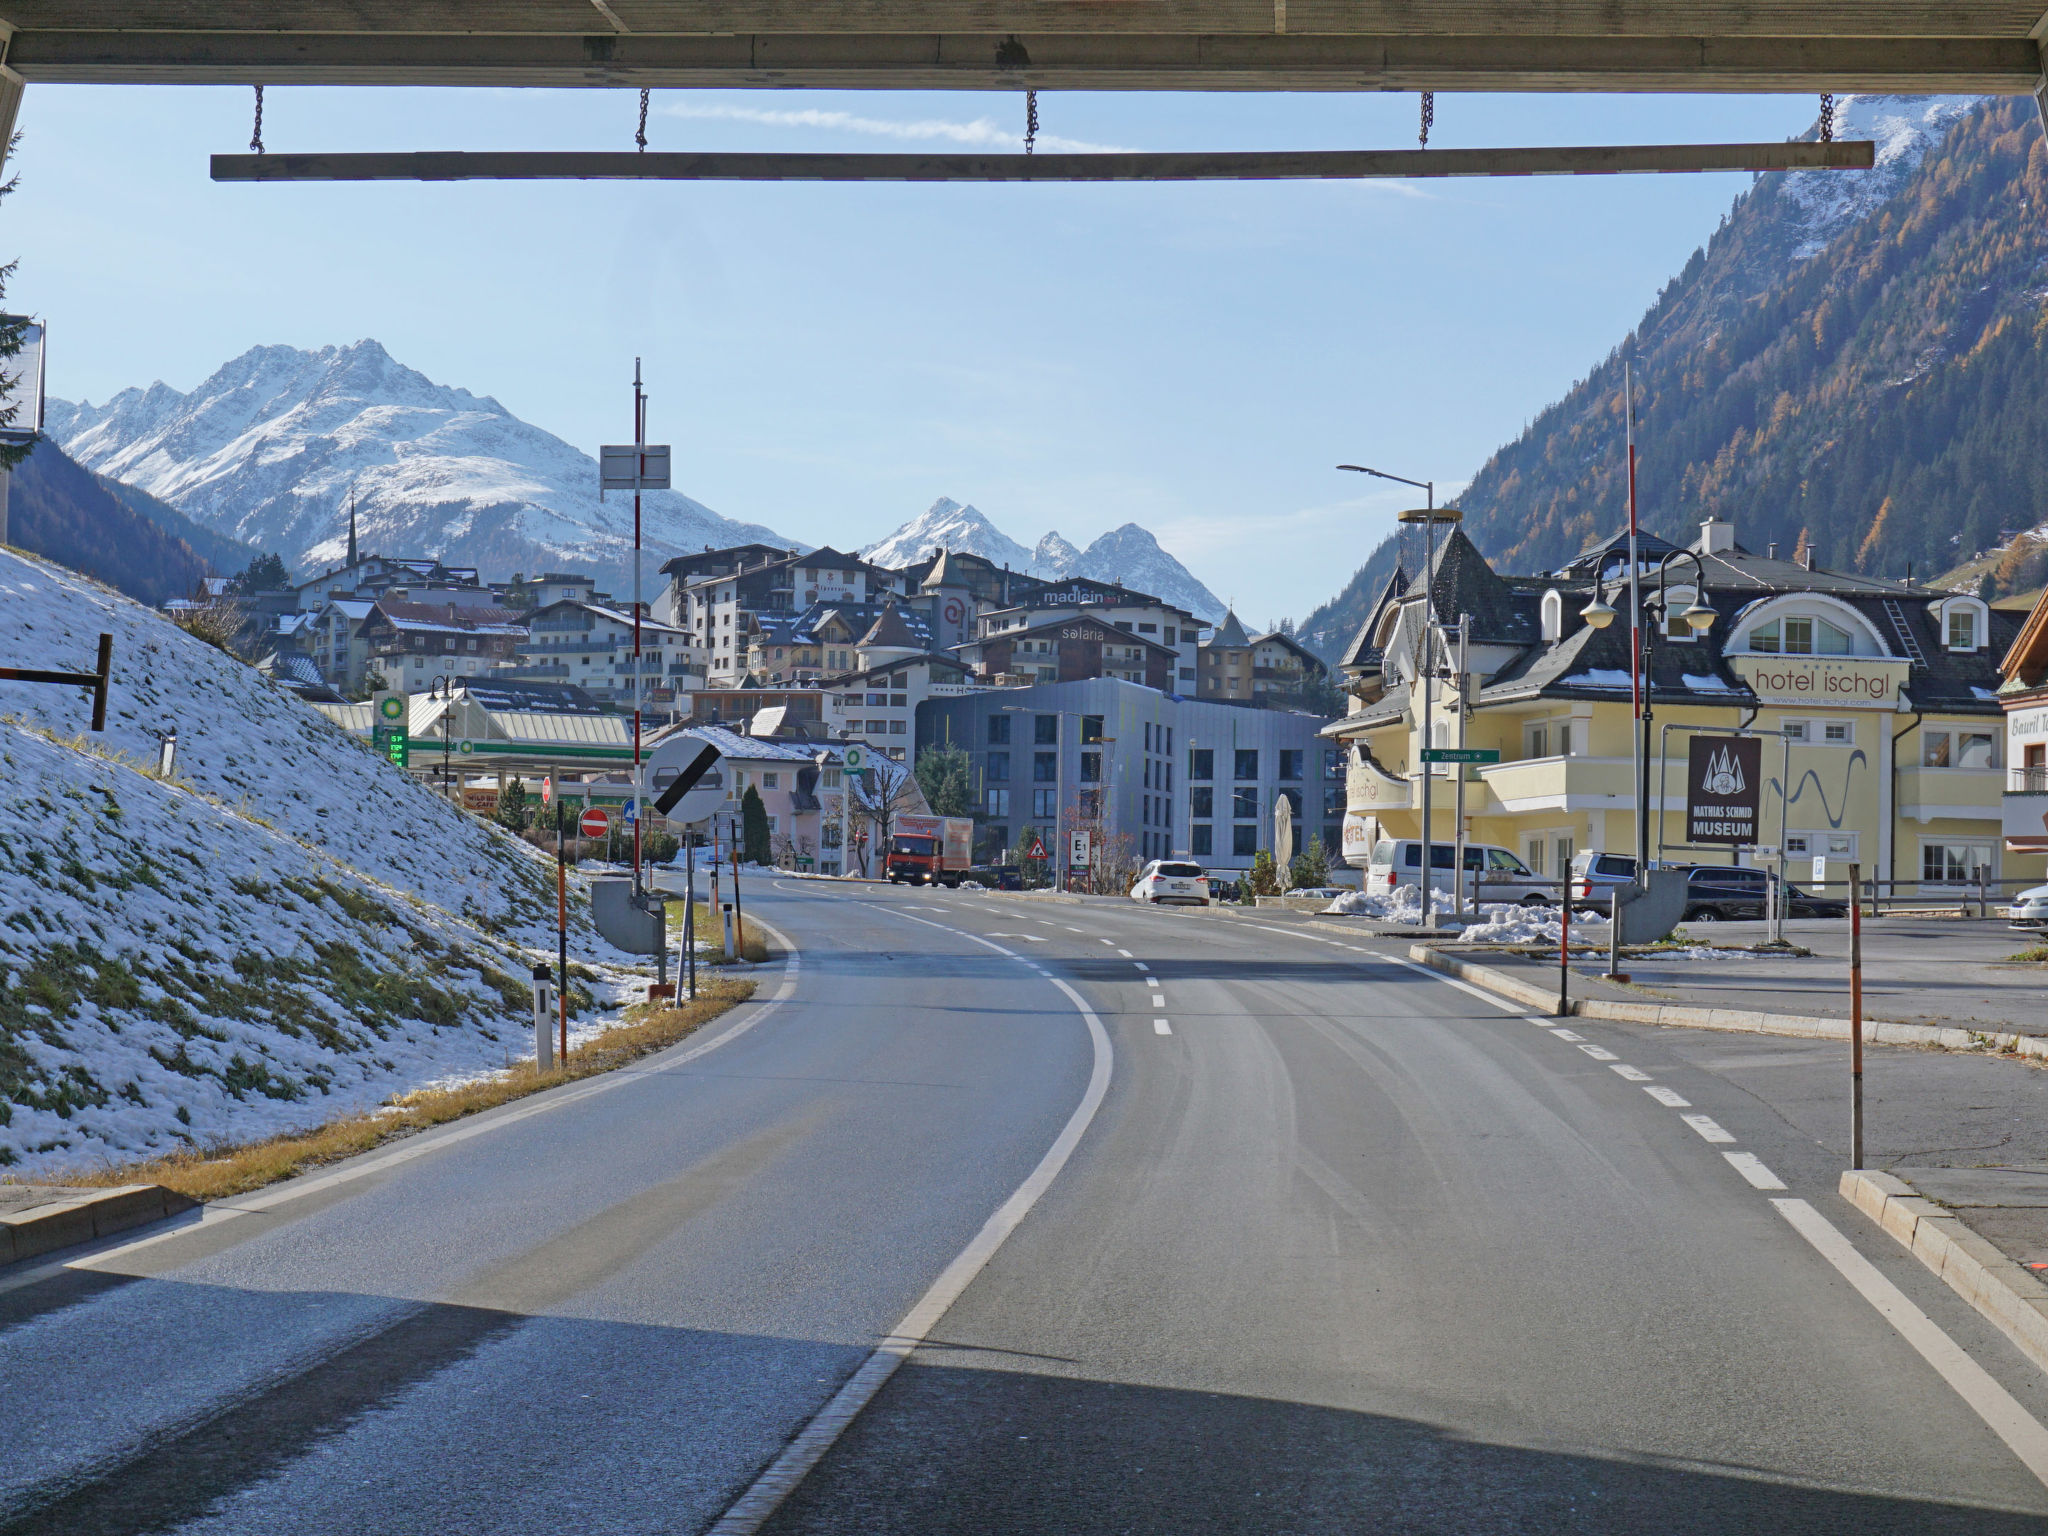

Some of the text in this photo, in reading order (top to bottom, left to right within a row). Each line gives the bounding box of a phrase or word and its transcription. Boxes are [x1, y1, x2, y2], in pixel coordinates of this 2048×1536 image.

[1044, 589, 1104, 603] madlein
[1756, 668, 1889, 699] hotel ischgl
[1441, 752, 1471, 760] Zentrum
[1693, 805, 1752, 818] MATHIAS SCHMID
[1693, 822, 1752, 836] MUSEUM
